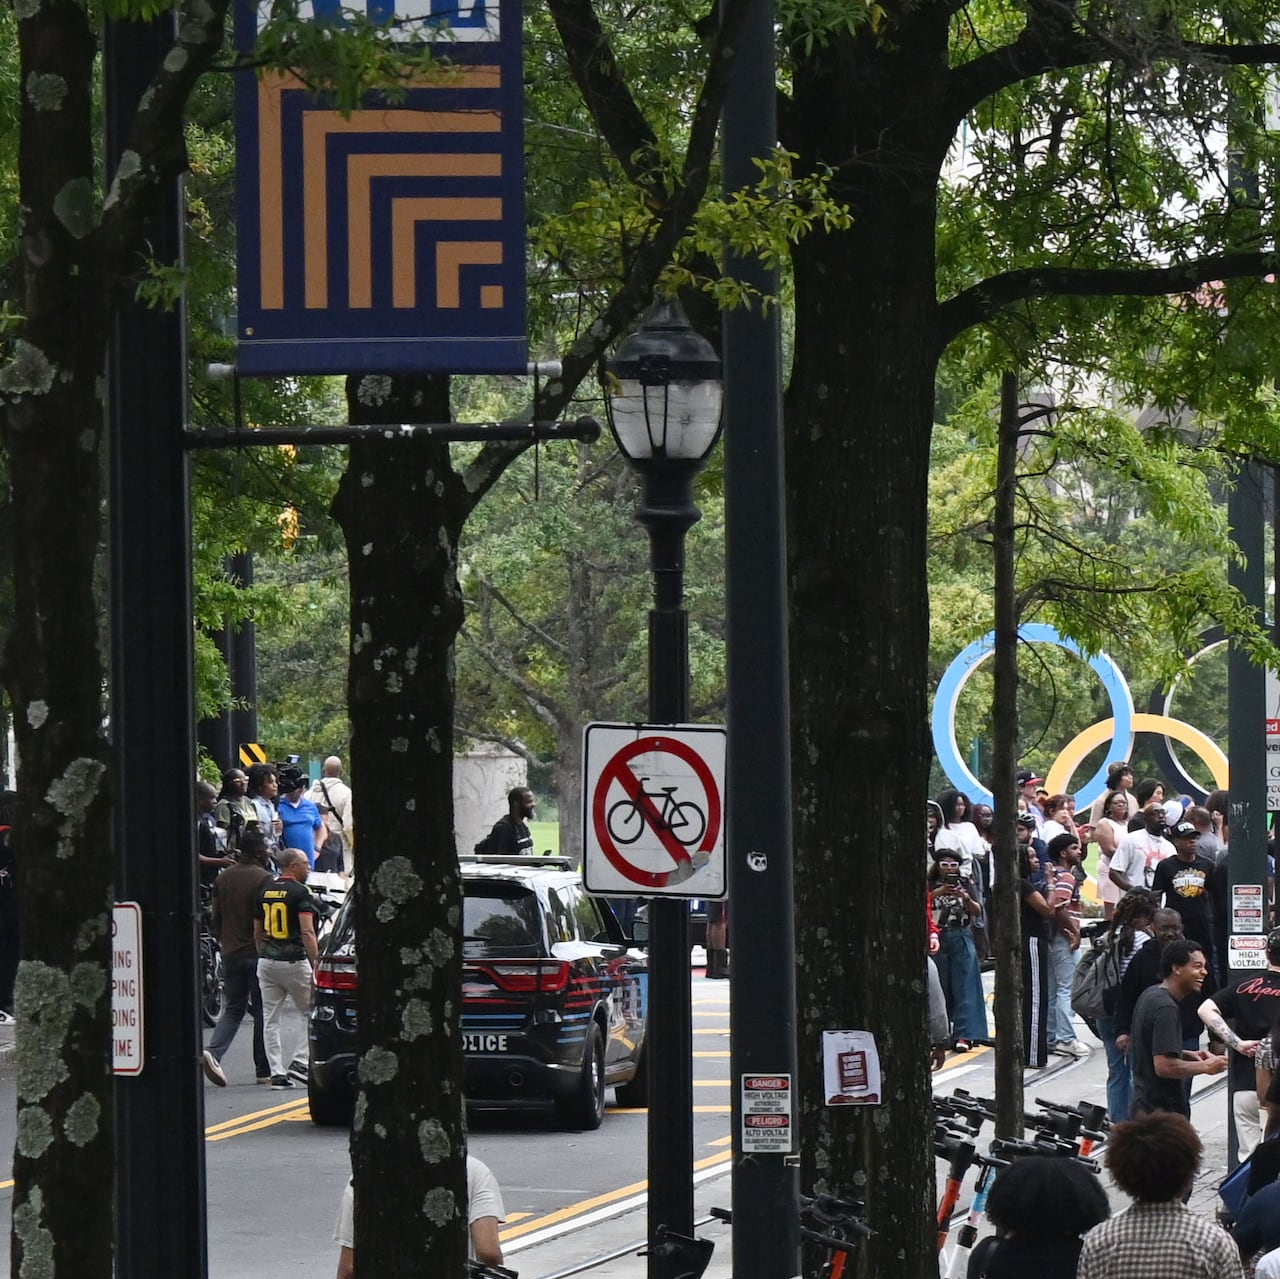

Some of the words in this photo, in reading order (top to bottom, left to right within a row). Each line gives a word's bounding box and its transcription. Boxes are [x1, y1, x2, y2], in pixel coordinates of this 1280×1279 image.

[1266, 722, 1278, 732] ed
[262, 902, 288, 939] 10
[461, 1035, 507, 1051] OLICE
[752, 1079, 782, 1088] DANGER
[745, 1092, 760, 1100] HIGH
[761, 1092, 788, 1100] VOLTAGE
[752, 1117, 782, 1125] PELIGRO
[745, 1129, 760, 1137] ALTO
[762, 1129, 788, 1137] VOLTAJE
